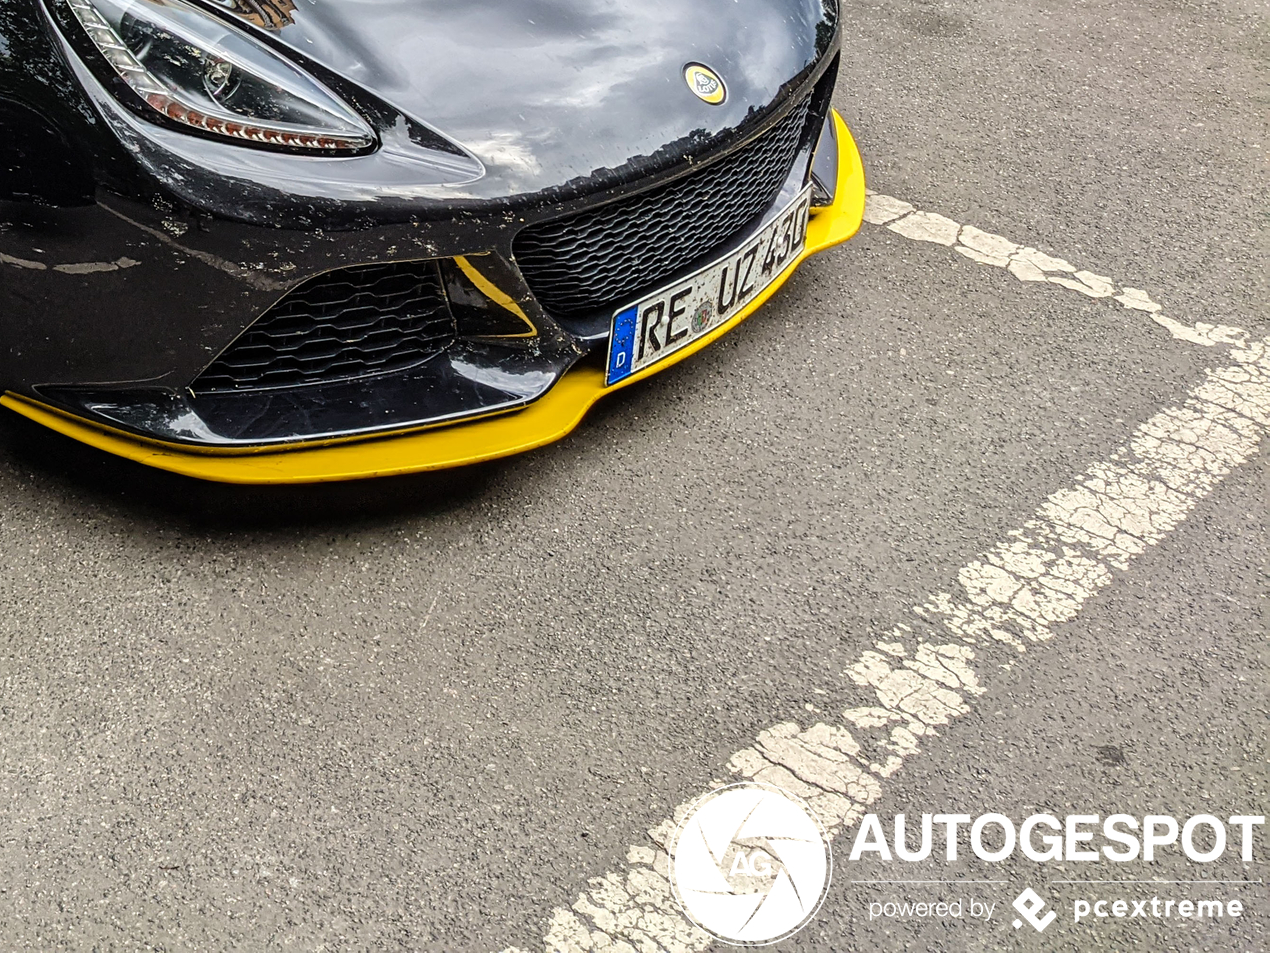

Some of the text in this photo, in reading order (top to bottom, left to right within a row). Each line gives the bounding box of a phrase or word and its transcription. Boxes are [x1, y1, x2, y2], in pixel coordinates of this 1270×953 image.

[637, 198, 809, 362] RE UZ 430
[615, 351, 626, 369] D
